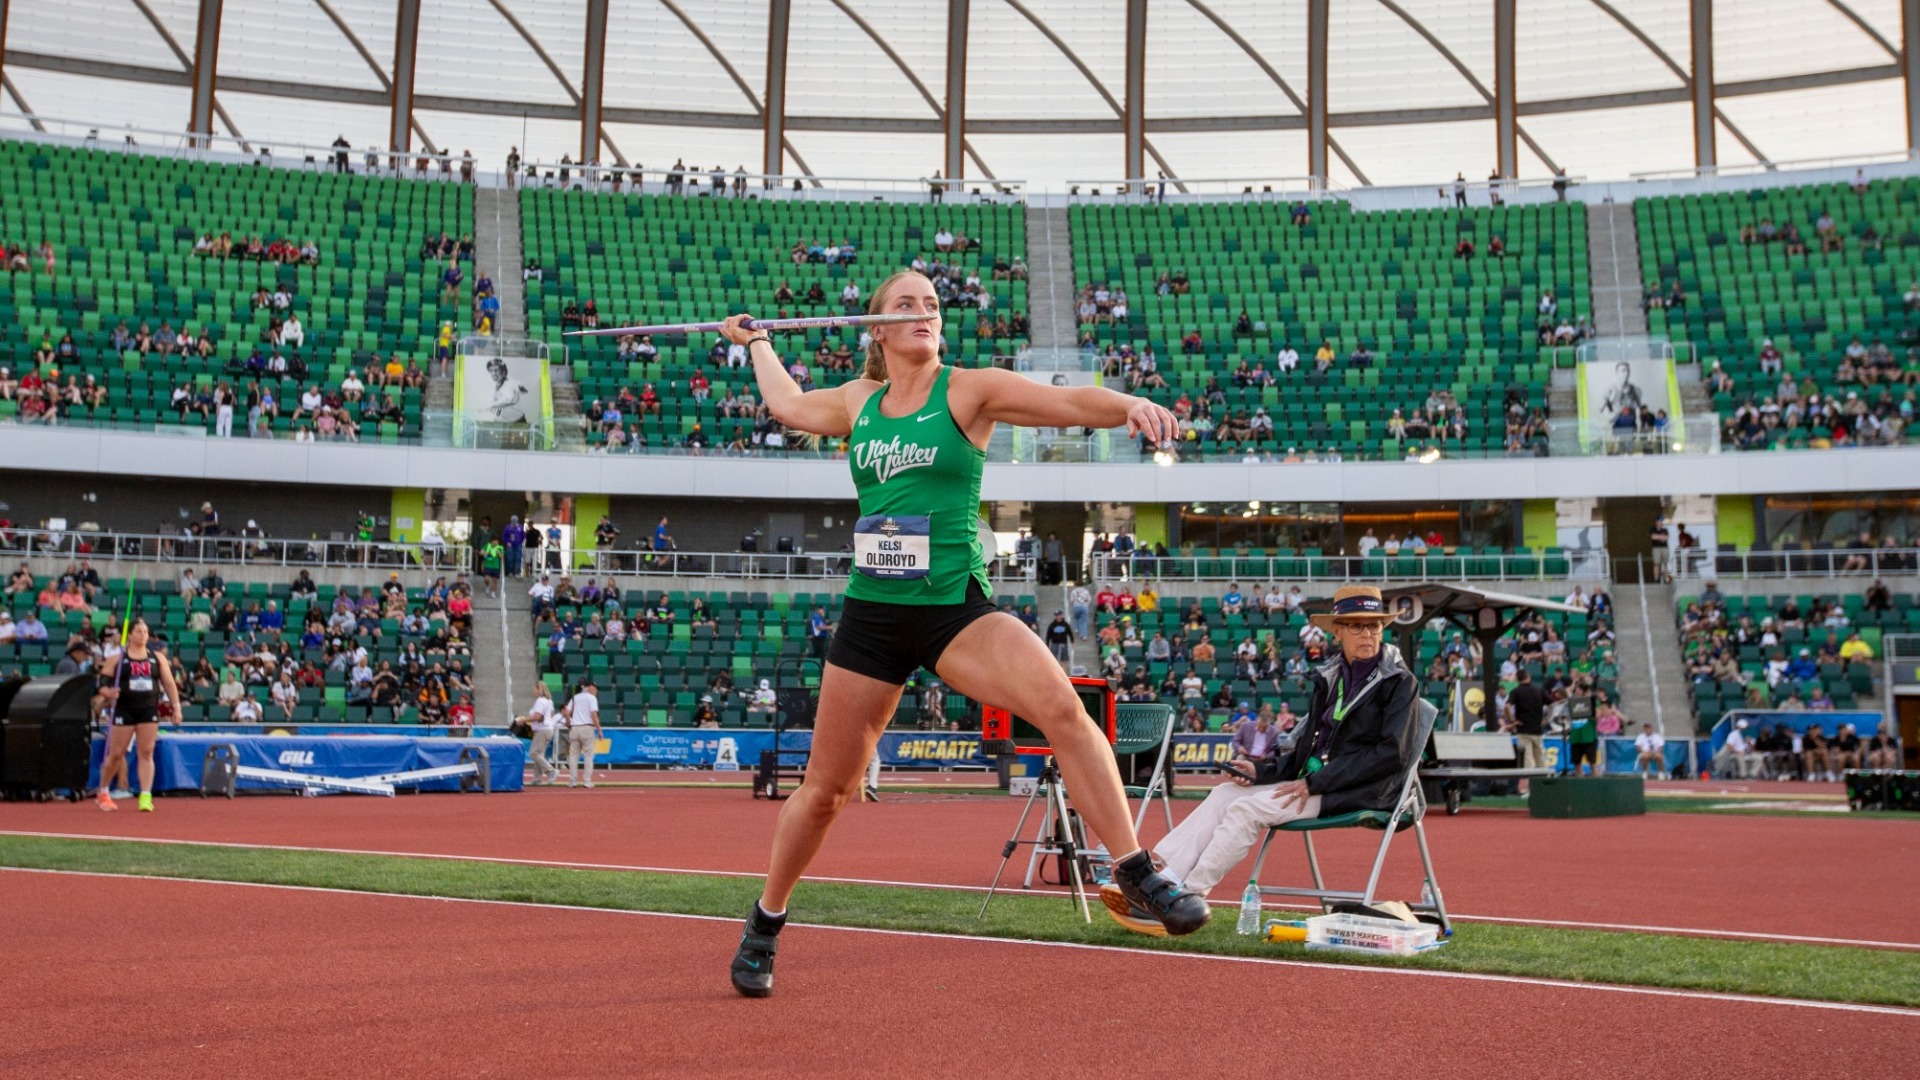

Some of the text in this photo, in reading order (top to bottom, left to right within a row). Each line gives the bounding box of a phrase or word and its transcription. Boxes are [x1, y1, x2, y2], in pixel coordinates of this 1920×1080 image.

[853, 435, 901, 469] Utah
[869, 442, 938, 484] Valley
[878, 540, 902, 550] KELSI
[866, 552, 916, 567] OLDROYD
[130, 662, 151, 676] N
[642, 734, 685, 746] Olympians
[636, 744, 688, 754] Paralympians
[721, 748, 732, 762] 4
[897, 740, 979, 760] #NCAATF
[1173, 743, 1209, 762] CAA
[278, 750, 314, 765] GILL
[1326, 928, 1388, 942] RUNWAY MARKERS
[1329, 937, 1351, 946] TACKS
